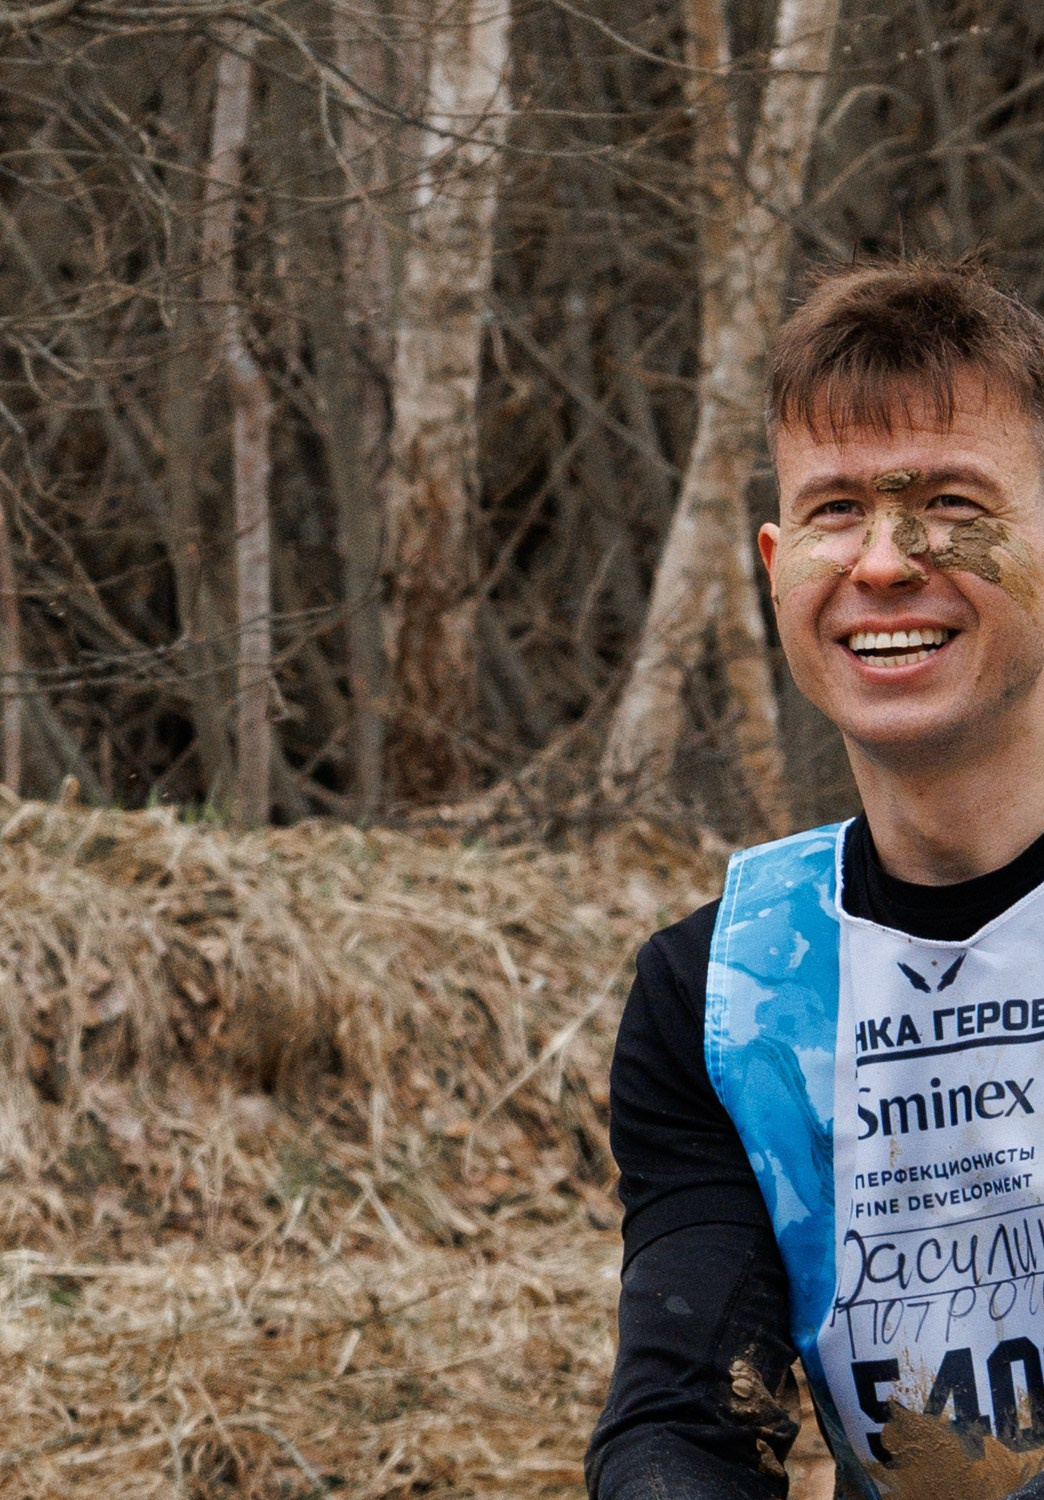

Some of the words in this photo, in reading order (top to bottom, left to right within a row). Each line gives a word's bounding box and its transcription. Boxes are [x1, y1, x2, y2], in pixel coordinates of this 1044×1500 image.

[856, 1077, 1035, 1141] Sminex
[855, 1146, 1036, 1190] ПЕРФЕКЦИОНИСТЫ
[855, 1198, 900, 1219] FINE
[908, 1173, 1034, 1214] DEVELOPMENT
